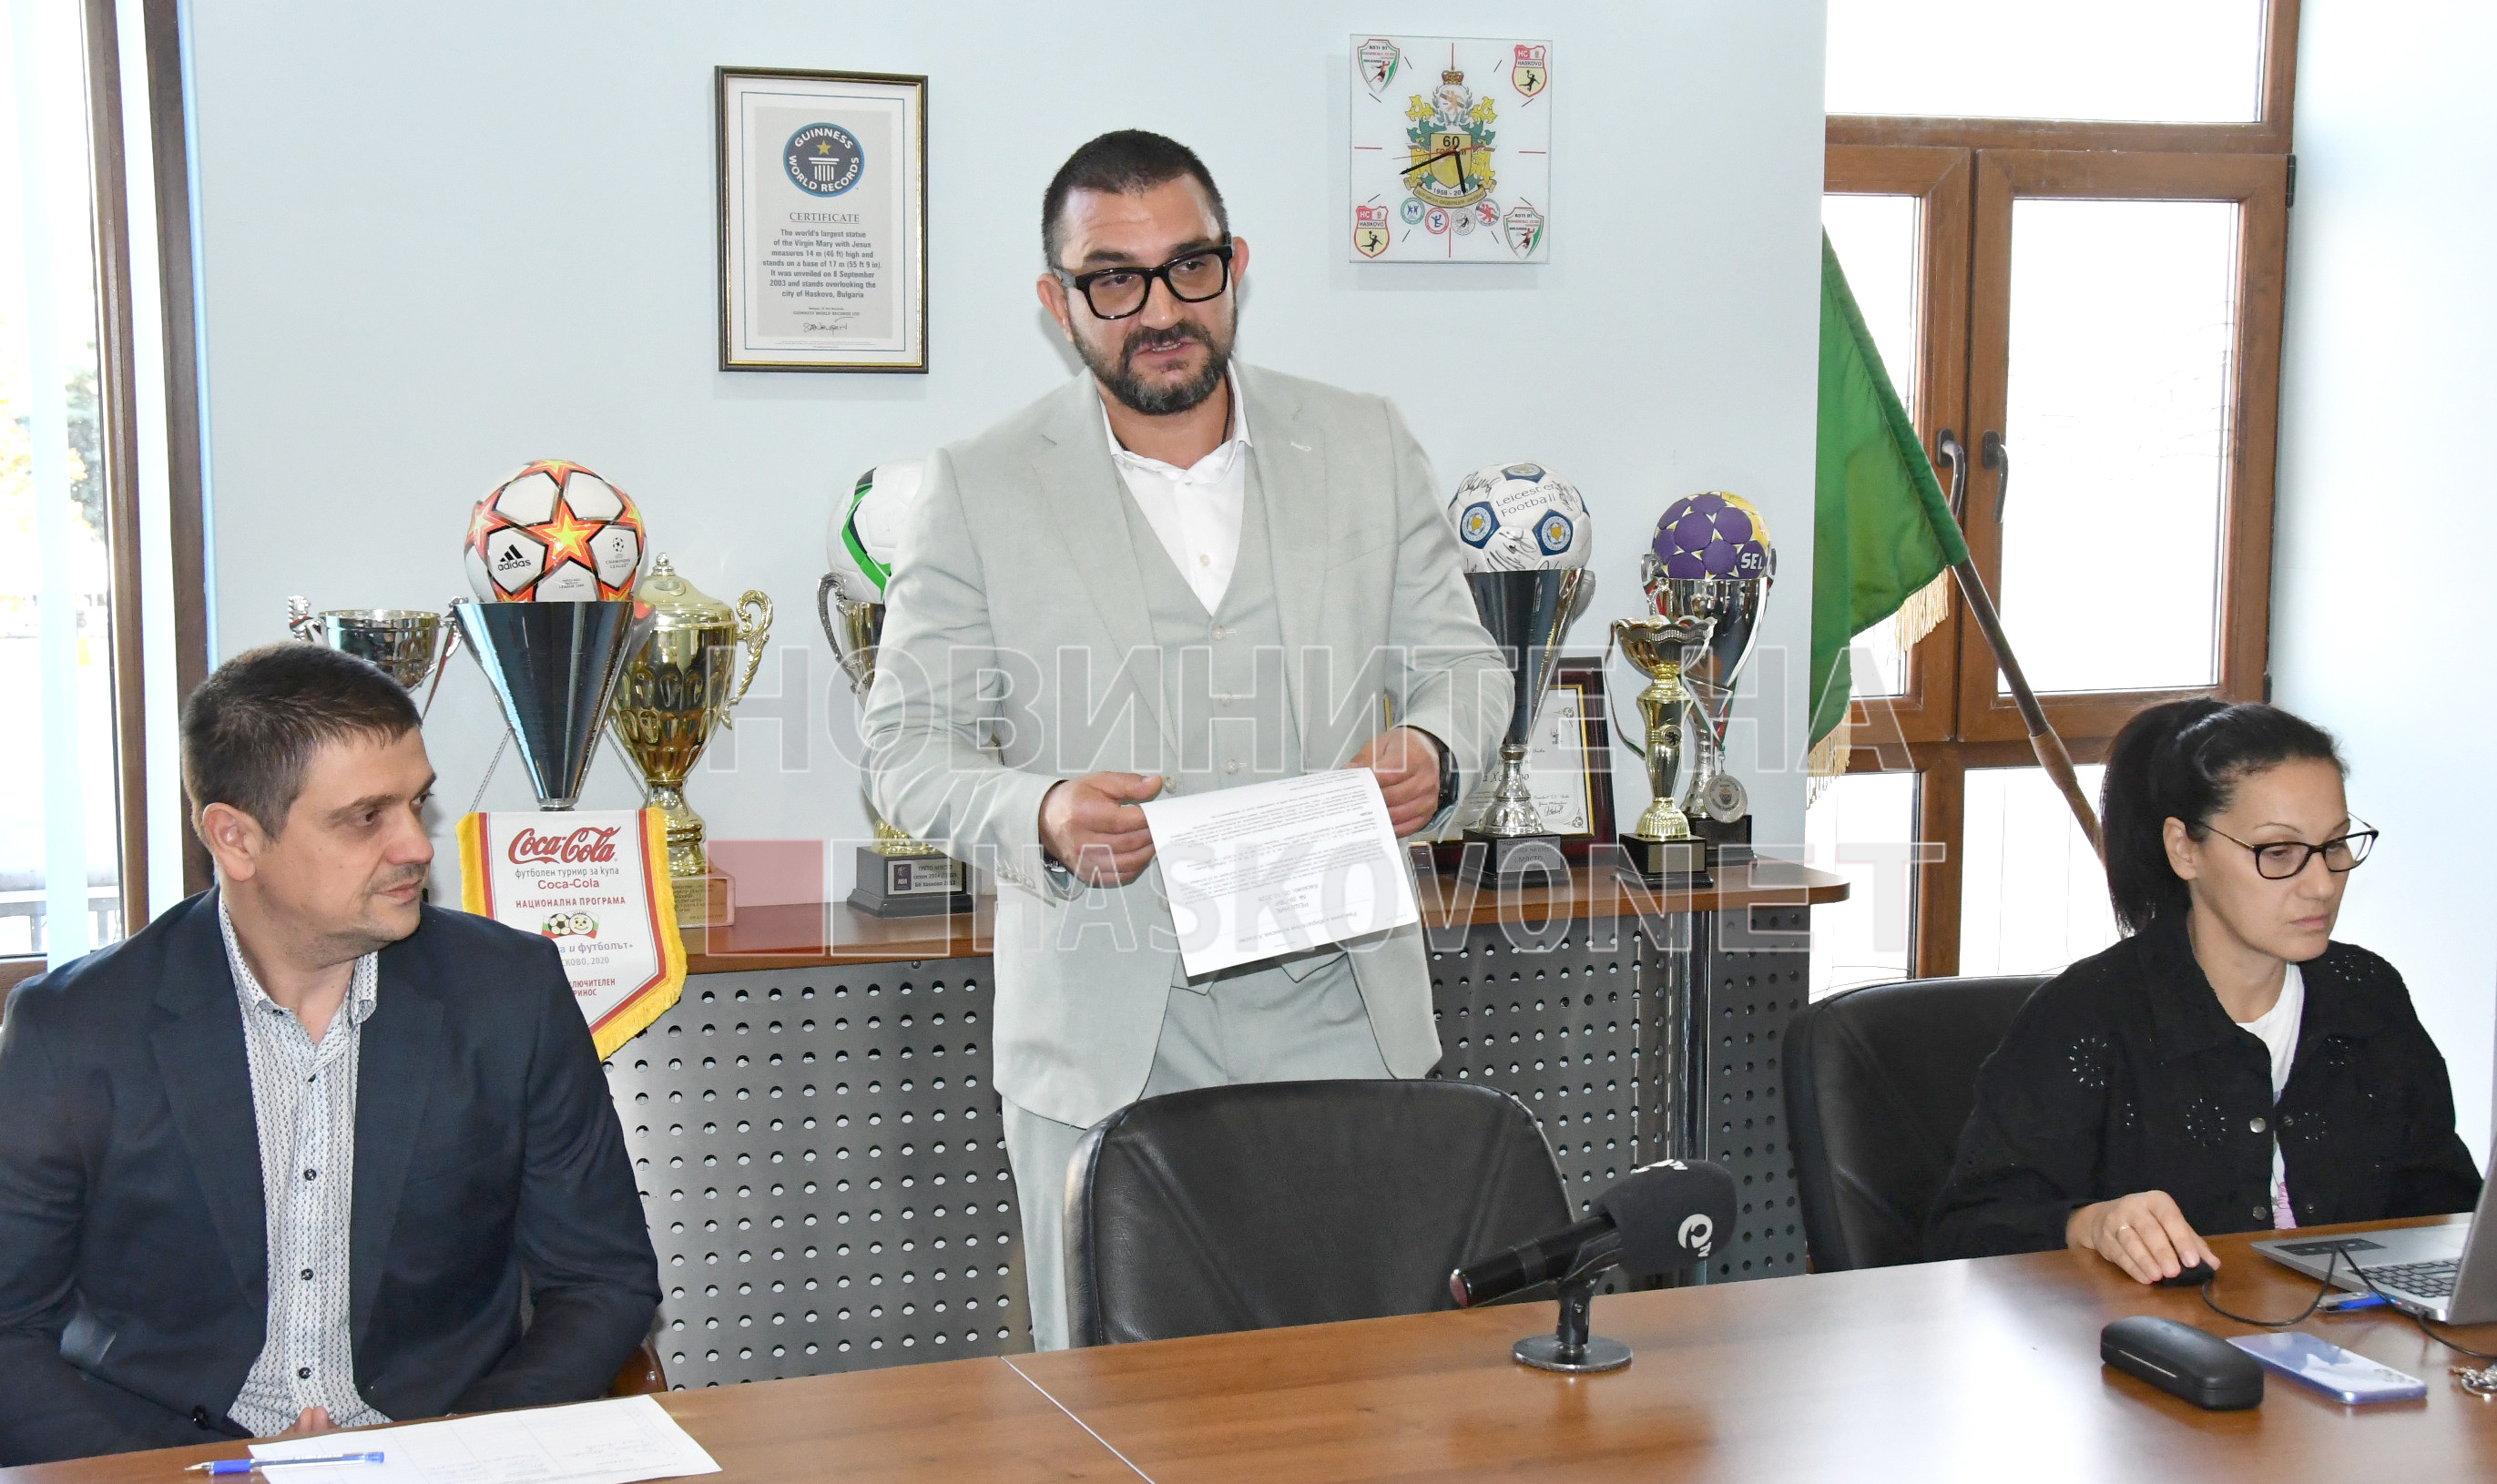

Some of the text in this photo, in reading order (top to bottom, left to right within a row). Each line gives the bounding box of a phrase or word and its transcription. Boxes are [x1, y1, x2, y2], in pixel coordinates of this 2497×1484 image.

[795, 128, 853, 149] GUINNESS
[1442, 136, 1460, 147] 60
[789, 155, 859, 192] WORLD RECORDS
[790, 212, 860, 222] CERTIFICATE
[820, 230, 843, 239] largest
[795, 239, 814, 248] Virgin
[816, 240, 832, 249] Mary
[840, 270, 874, 279] September
[826, 280, 863, 290] overlooking
[805, 290, 834, 299] Haskovo,
[1501, 493, 1556, 517] Football
[497, 559, 531, 571] adidas
[508, 826, 621, 864] Coca-Cola
[515, 869, 555, 879] футболен
[558, 869, 587, 878] турнир
[600, 866, 618, 878] купа
[537, 878, 599, 889] Coca-Cola
[515, 897, 626, 909] НАЦИОНАЛНА ПРОГРАМА
[561, 958, 589, 966] СКОВО,
[569, 979, 616, 988] ЛЮЧИТЕЛЕН
